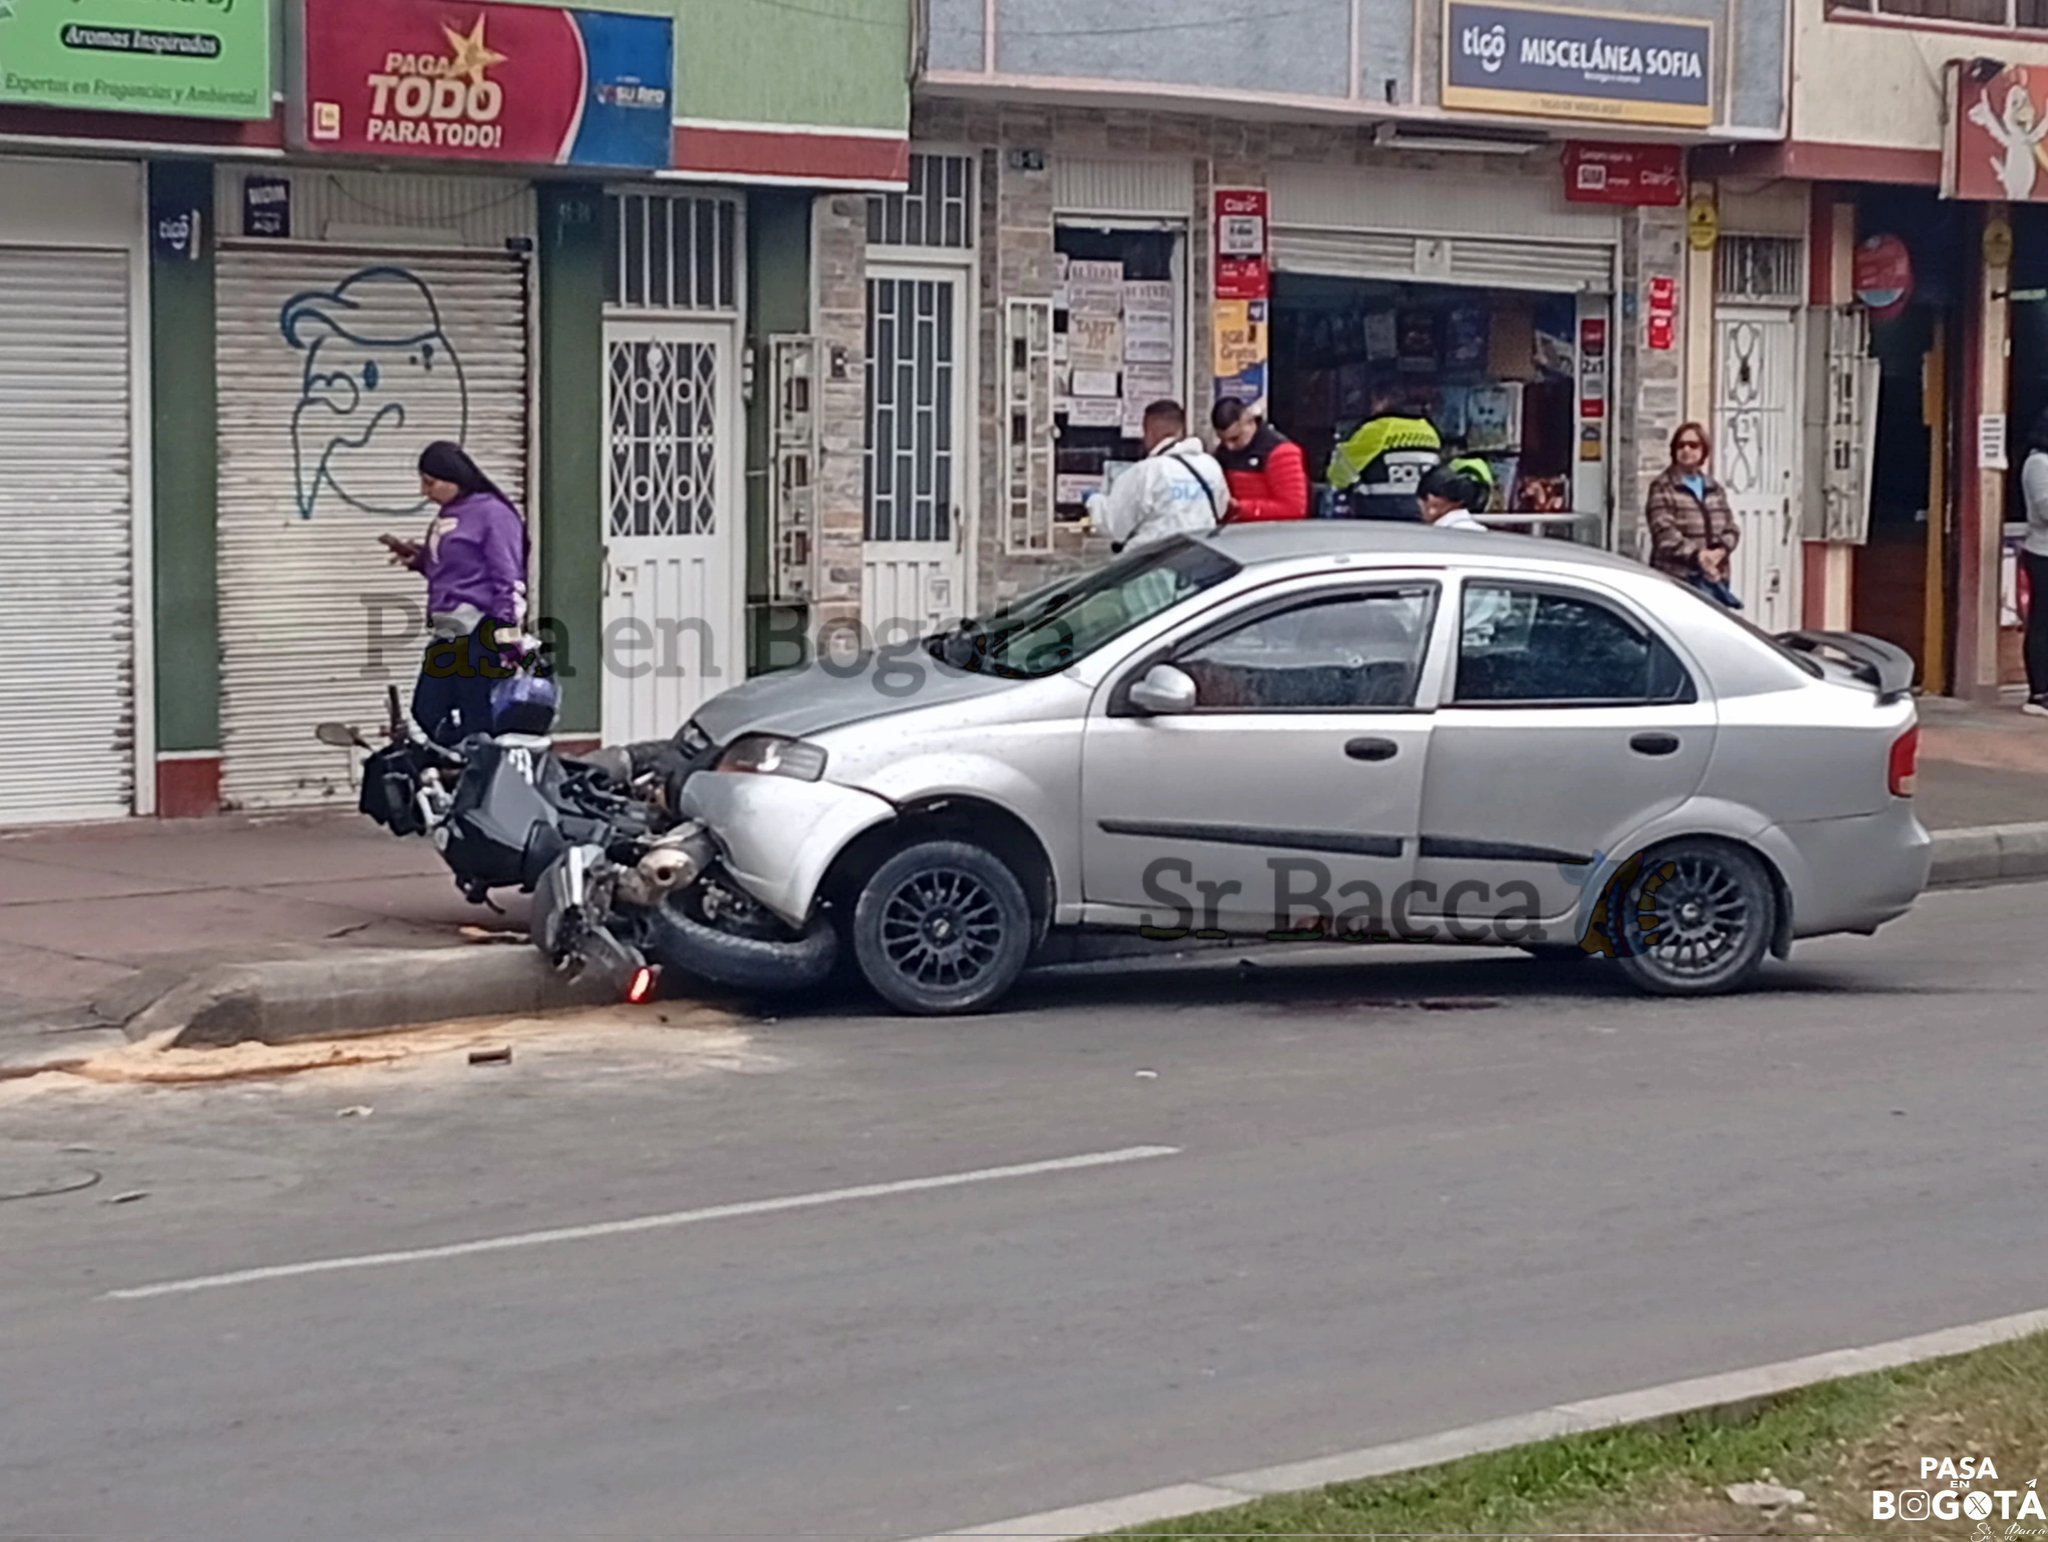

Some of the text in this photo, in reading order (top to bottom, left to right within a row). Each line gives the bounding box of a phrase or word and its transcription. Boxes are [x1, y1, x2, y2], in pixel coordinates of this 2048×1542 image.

[65, 25, 130, 49] Aromas
[384, 52, 451, 77] PAGA
[1520, 37, 1701, 78] MISCELÁNEA SOFIA
[72, 80, 91, 95] en
[173, 90, 183, 104] y
[367, 74, 502, 121] TODO
[366, 118, 501, 148] PARA TODO!
